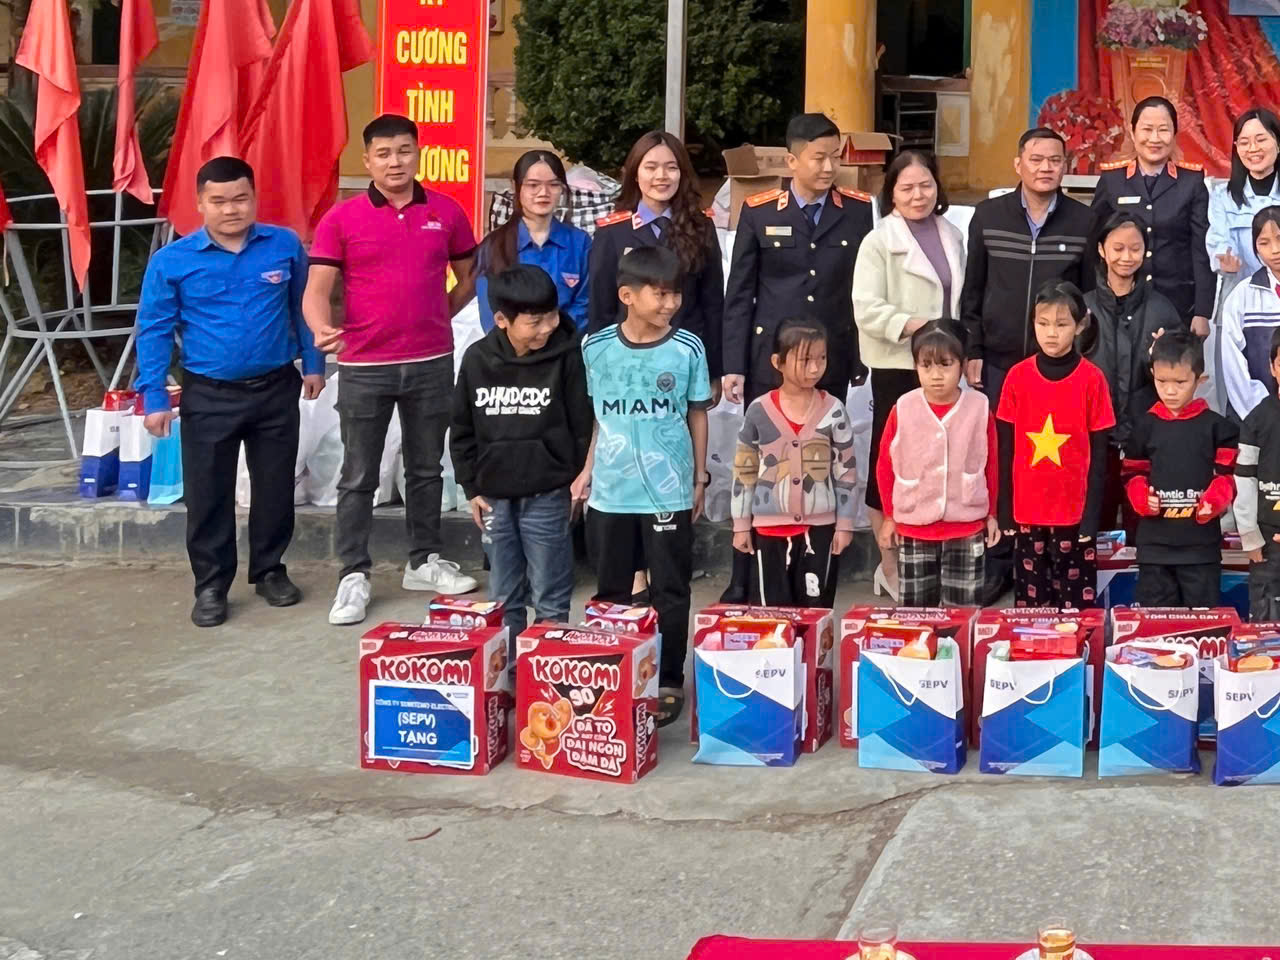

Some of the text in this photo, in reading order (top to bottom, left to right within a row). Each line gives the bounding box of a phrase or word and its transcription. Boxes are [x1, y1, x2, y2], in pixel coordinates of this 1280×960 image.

[396, 28, 467, 65] CƯƠNG
[407, 84, 454, 123] TÌNH
[414, 145, 469, 182] ƯƠNG
[378, 657, 471, 685] KOKOMI
[533, 657, 621, 691] KOKOMI
[569, 688, 595, 707] 90
[398, 712, 436, 729] (SEPV)
[595, 722, 612, 734] TO
[588, 741, 623, 757] NGON
